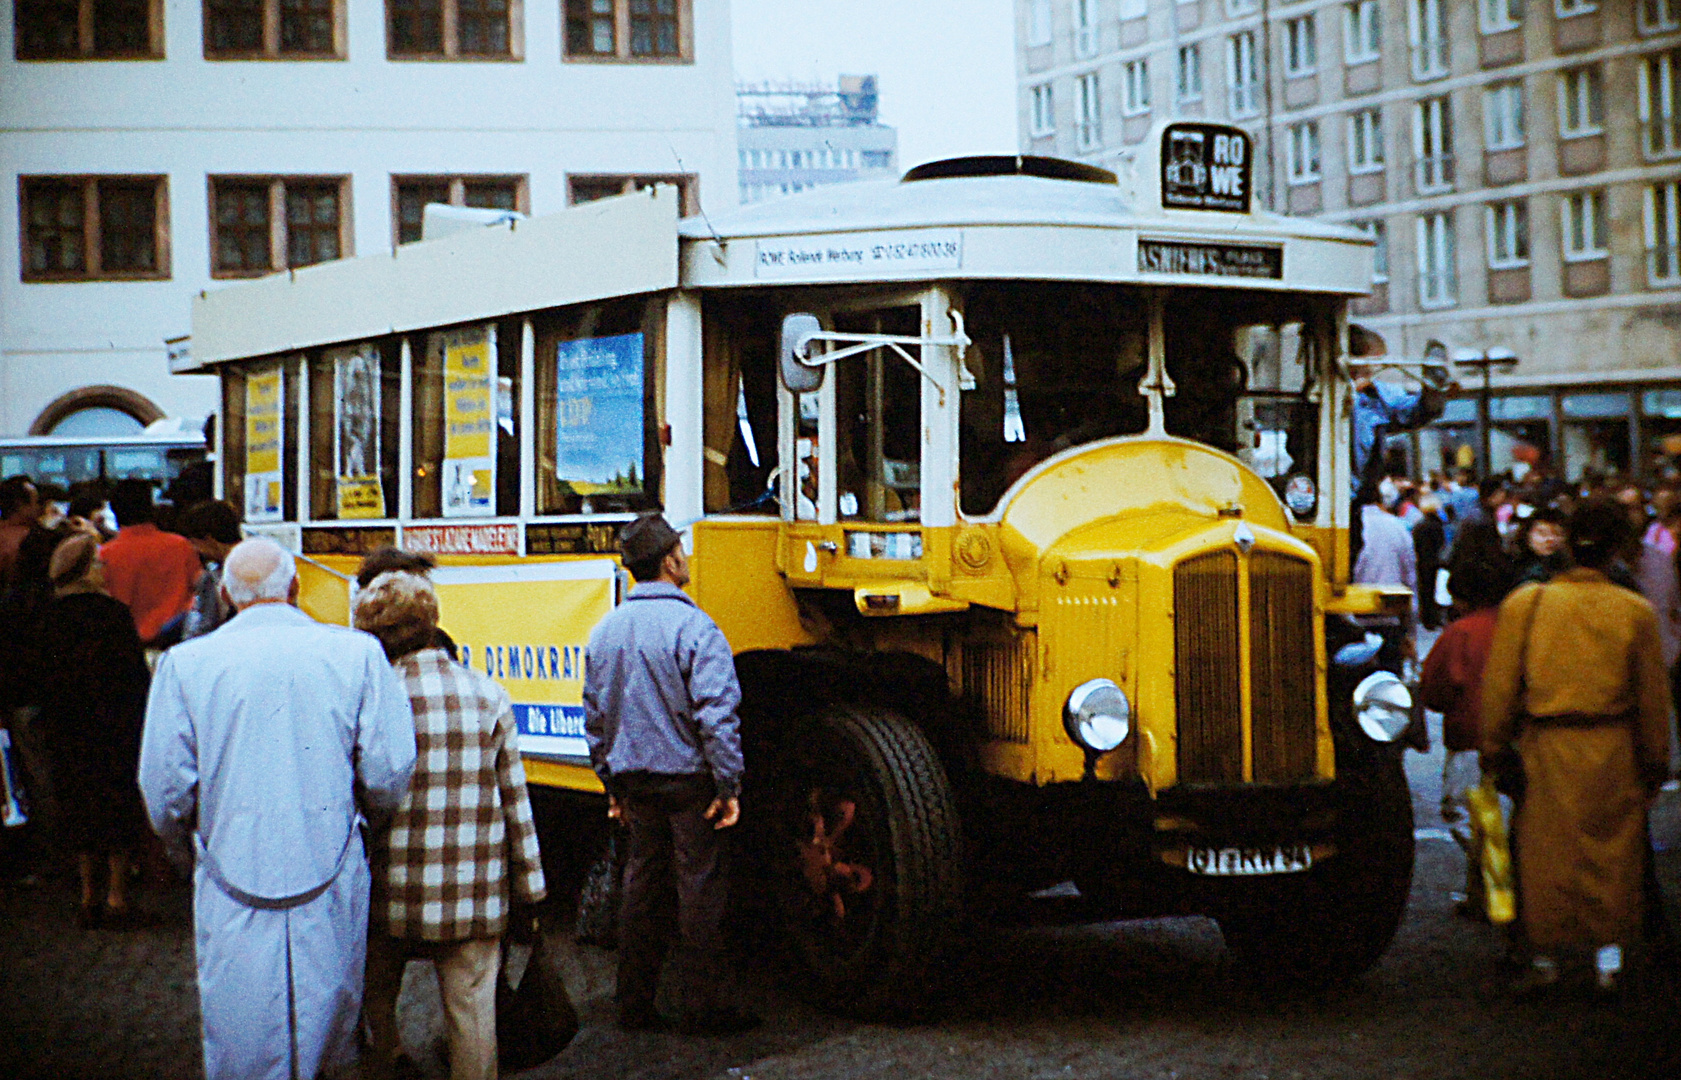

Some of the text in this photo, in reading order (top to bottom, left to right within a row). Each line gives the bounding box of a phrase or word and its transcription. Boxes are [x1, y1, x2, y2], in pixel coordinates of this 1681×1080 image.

[1214, 133, 1244, 165] RO
[1210, 165, 1243, 196] WE
[528, 707, 547, 734] Die
